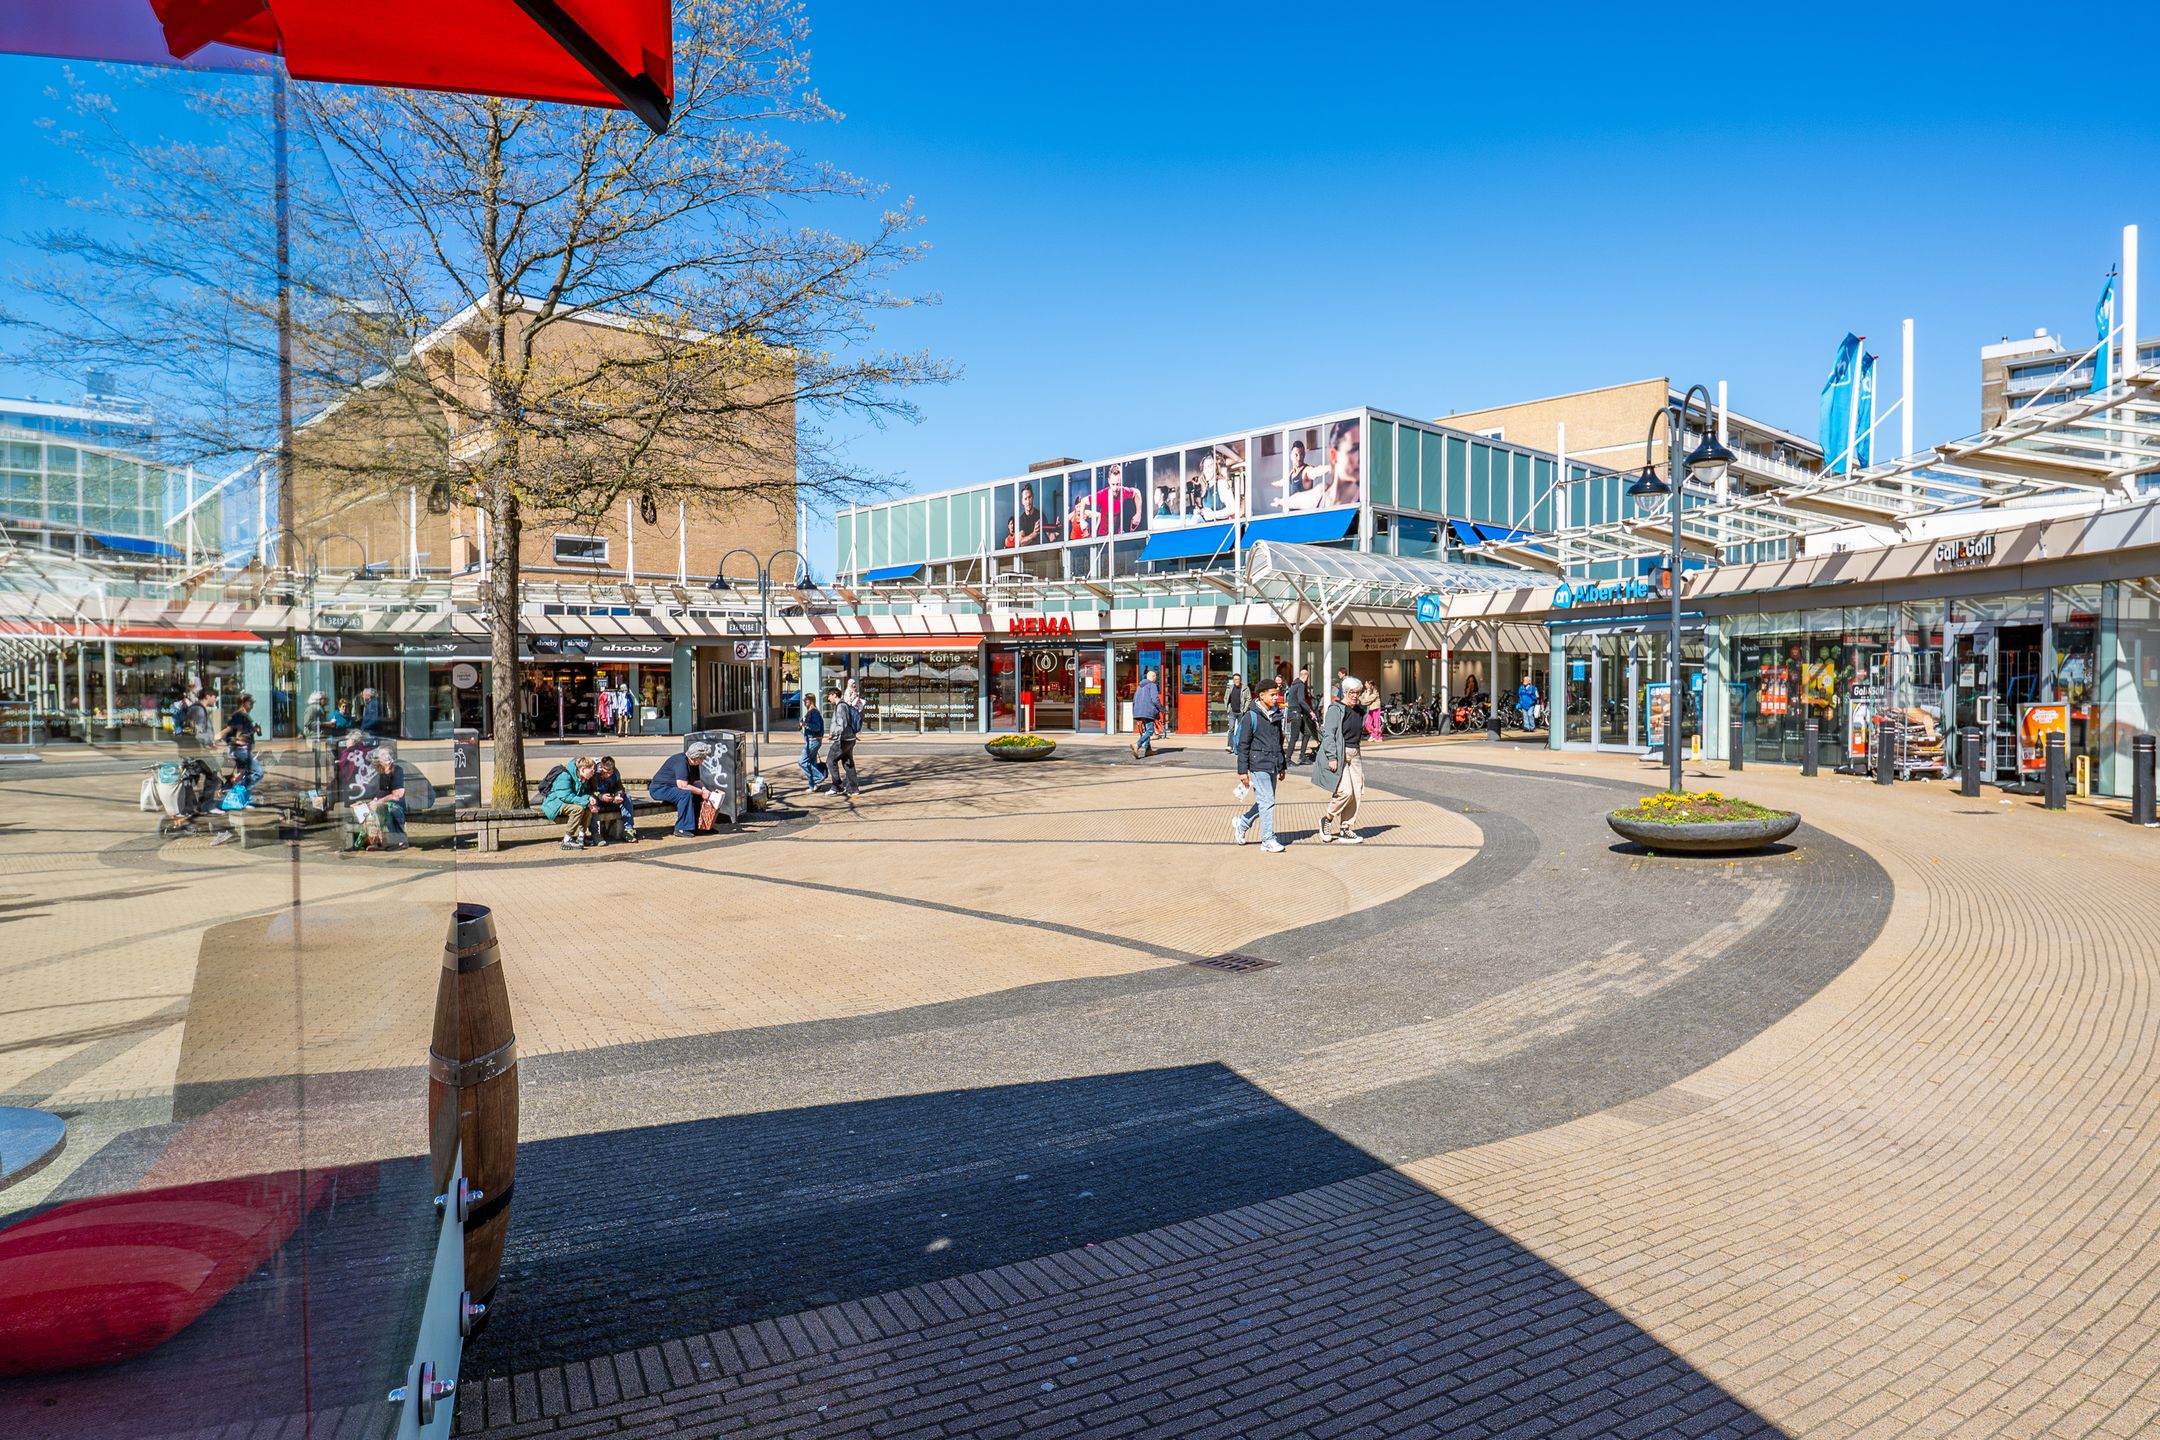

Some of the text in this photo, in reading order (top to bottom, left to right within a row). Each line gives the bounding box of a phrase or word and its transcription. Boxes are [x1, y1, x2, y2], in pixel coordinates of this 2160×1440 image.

[1574, 582, 1622, 603] Albert
[1625, 580, 1648, 598] He
[1009, 617, 1072, 636] HEMA
[602, 645, 662, 653] shoeby
